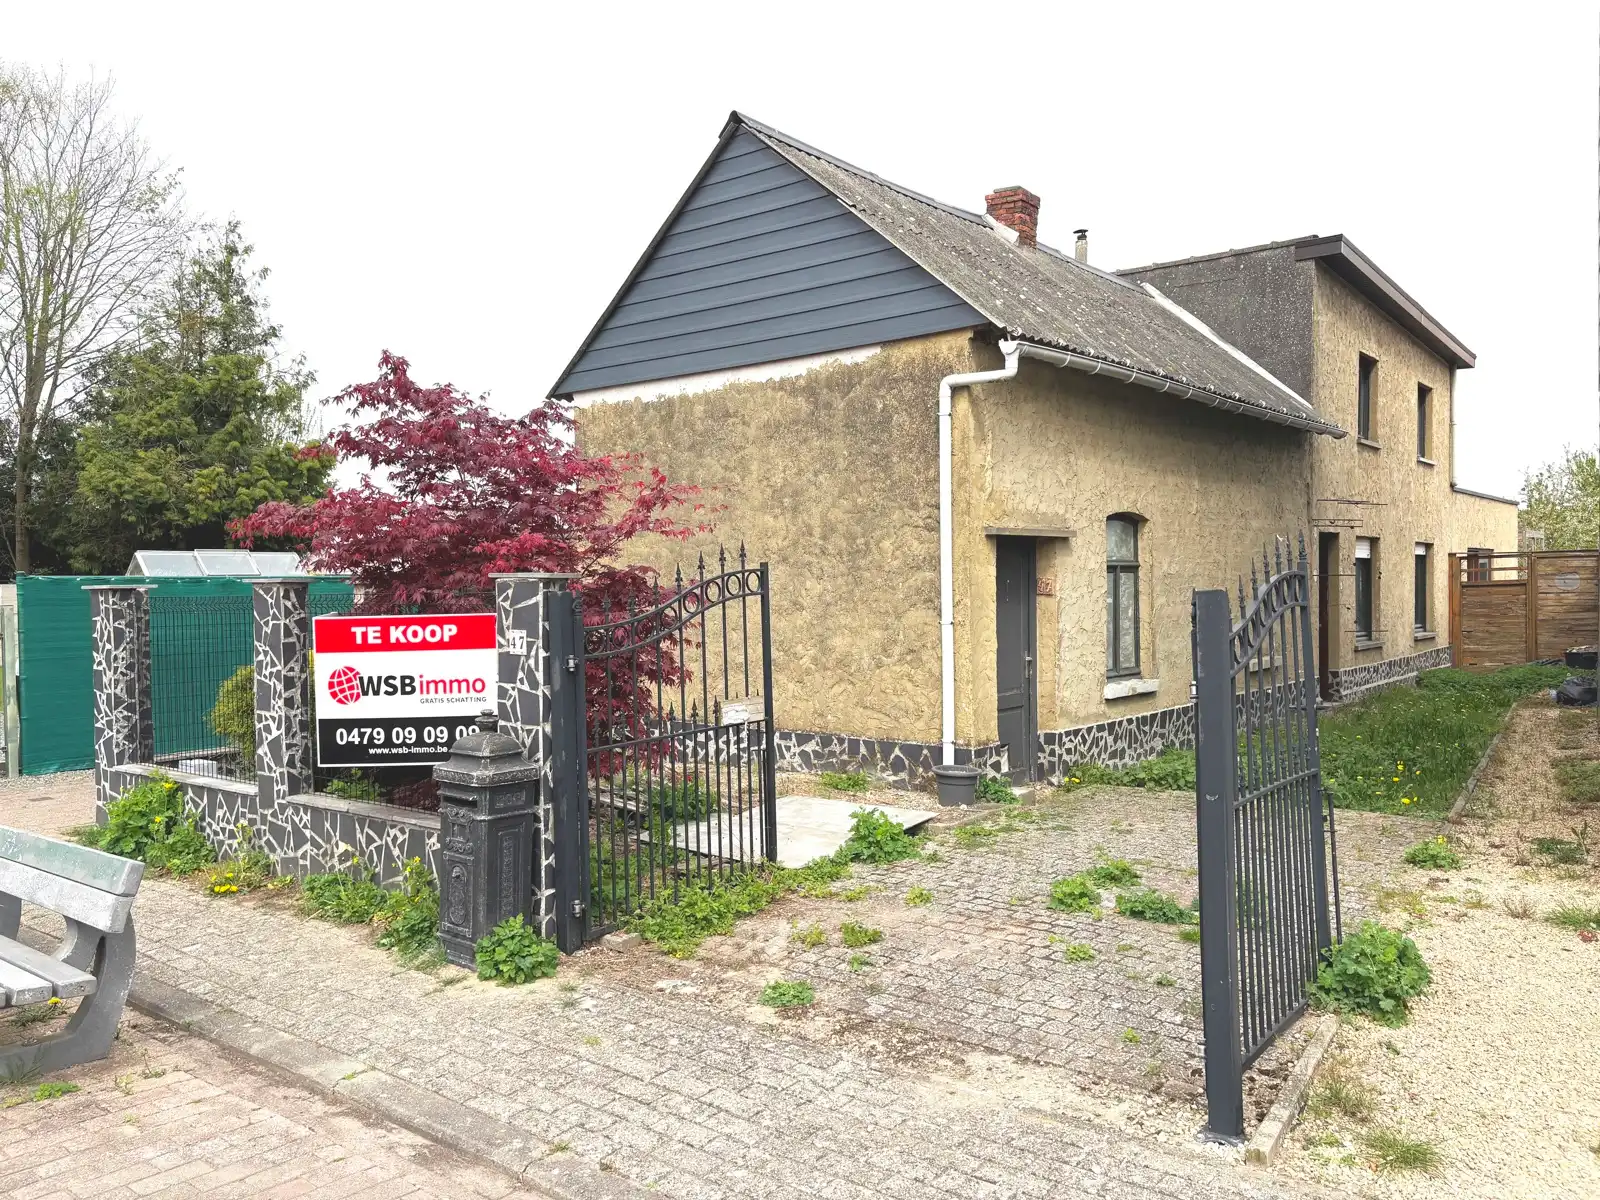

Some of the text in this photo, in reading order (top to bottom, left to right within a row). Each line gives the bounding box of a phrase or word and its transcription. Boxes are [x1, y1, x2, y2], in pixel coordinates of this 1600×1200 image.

[351, 624, 458, 645] TE KOOP
[510, 635, 525, 650] 47
[446, 696, 487, 704] SCHATTING
[335, 727, 385, 746] 0479
[391, 726, 417, 745] 09
[423, 725, 449, 744] 09
[368, 744, 449, 755] www.wsb-immo.be
